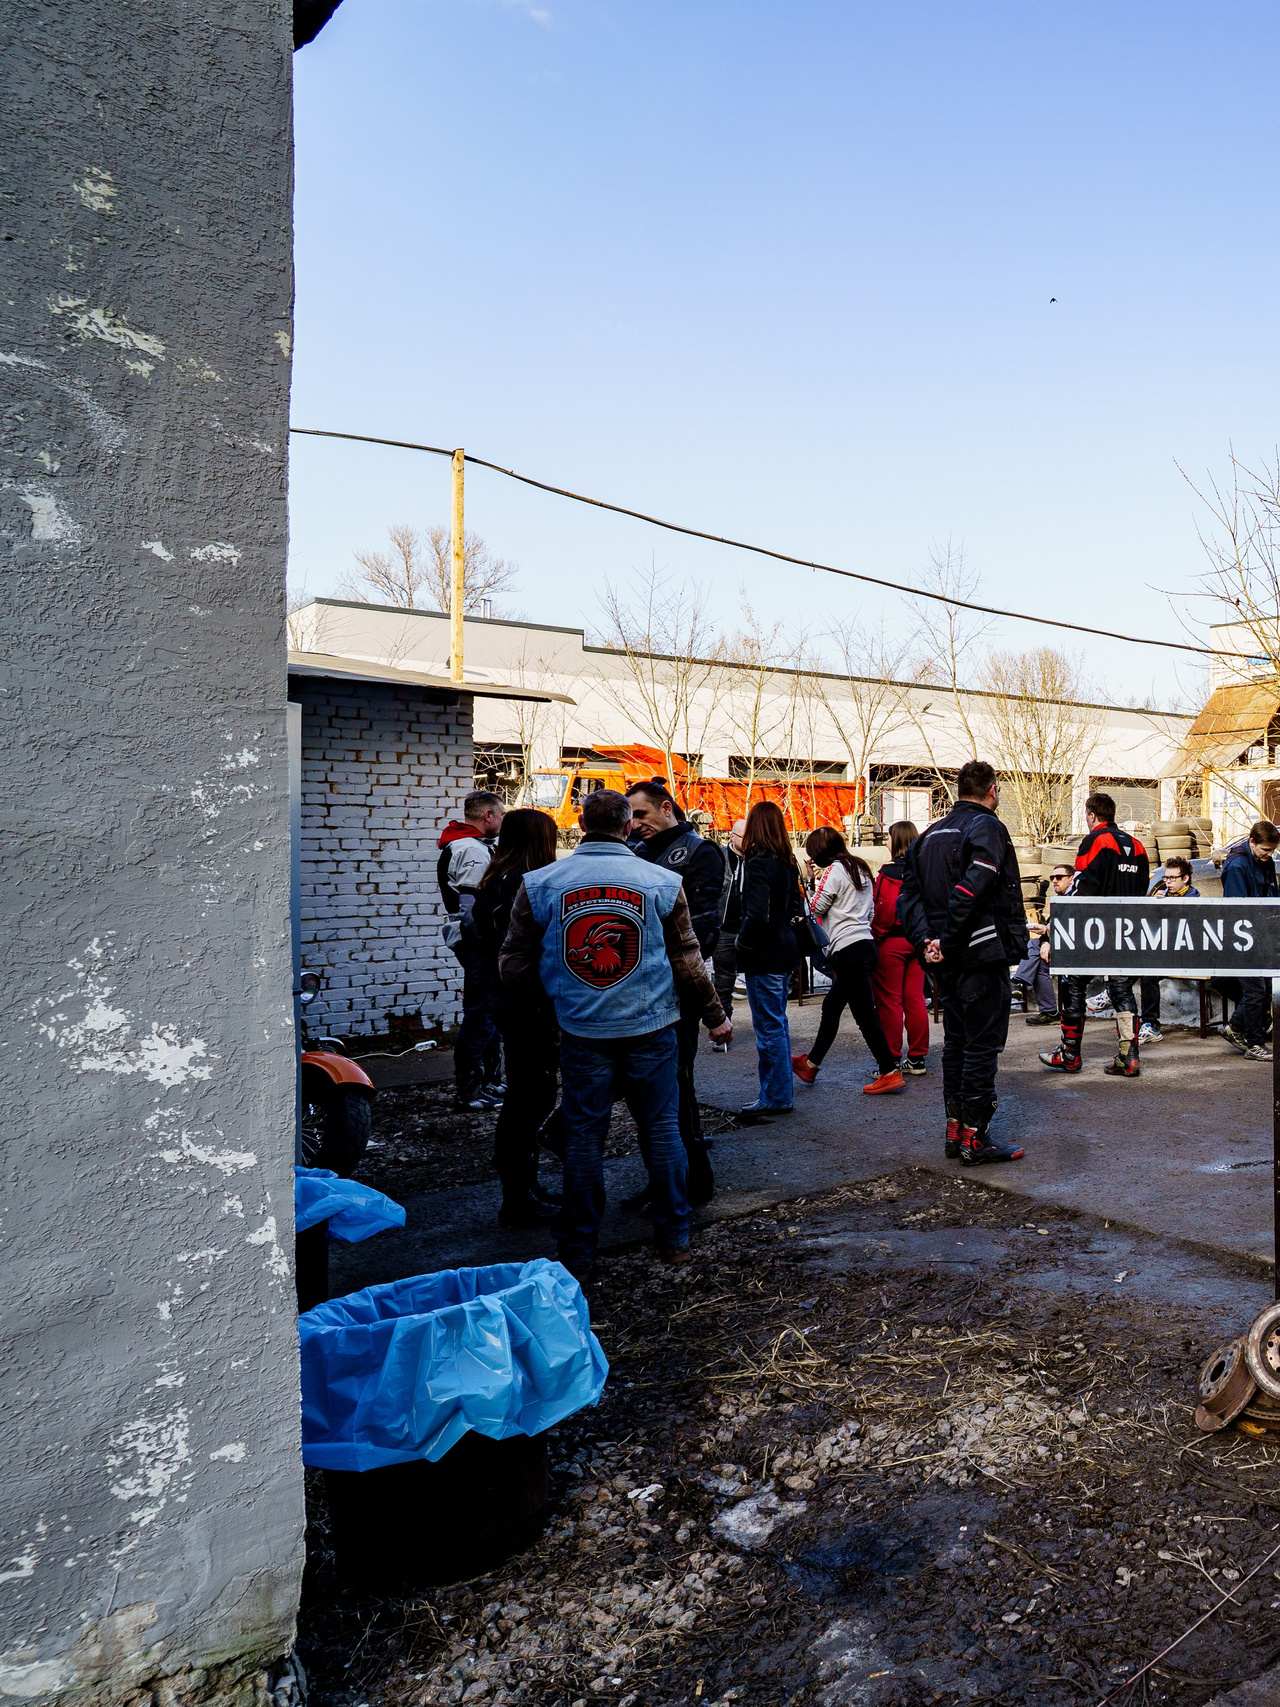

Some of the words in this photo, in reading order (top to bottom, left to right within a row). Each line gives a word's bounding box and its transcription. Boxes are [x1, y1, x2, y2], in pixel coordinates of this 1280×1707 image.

[566, 888, 601, 907] RED
[605, 888, 642, 906] HOG
[567, 898, 640, 911] ST.PETERSBURG
[1053, 917, 1255, 952] NORMANS
